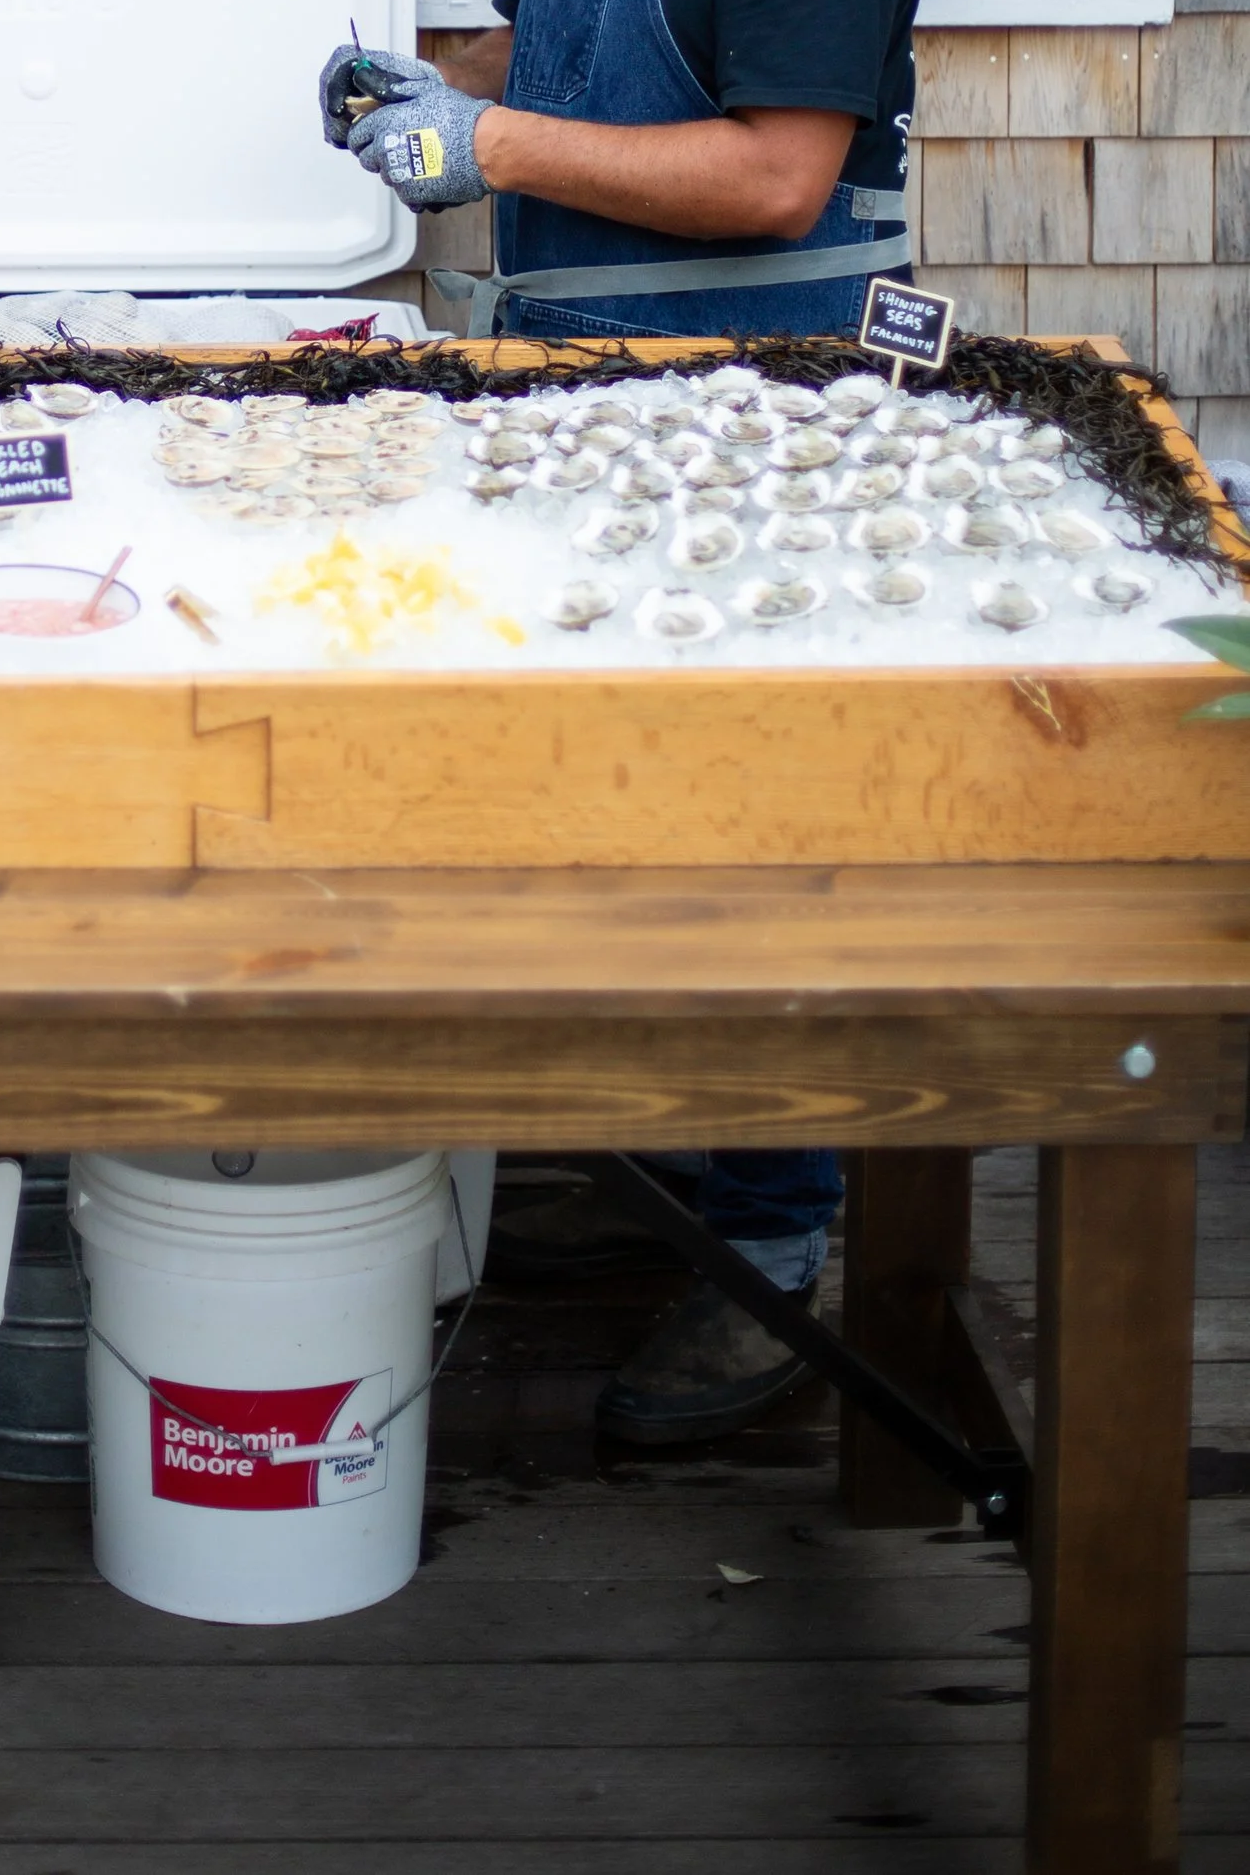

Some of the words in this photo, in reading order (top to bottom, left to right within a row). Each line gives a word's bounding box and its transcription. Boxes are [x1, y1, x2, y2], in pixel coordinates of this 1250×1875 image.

[410, 138, 421, 155] FIT
[411, 156, 425, 176] DEX
[877, 291, 938, 317] SHINING
[886, 309, 923, 331] SEAS
[870, 326, 935, 354] FALMOUTH
[163, 1418, 296, 1454] Benjamin
[164, 1445, 254, 1477] Moore
[334, 1456, 376, 1477] Moore
[342, 1471, 367, 1485] Paints
